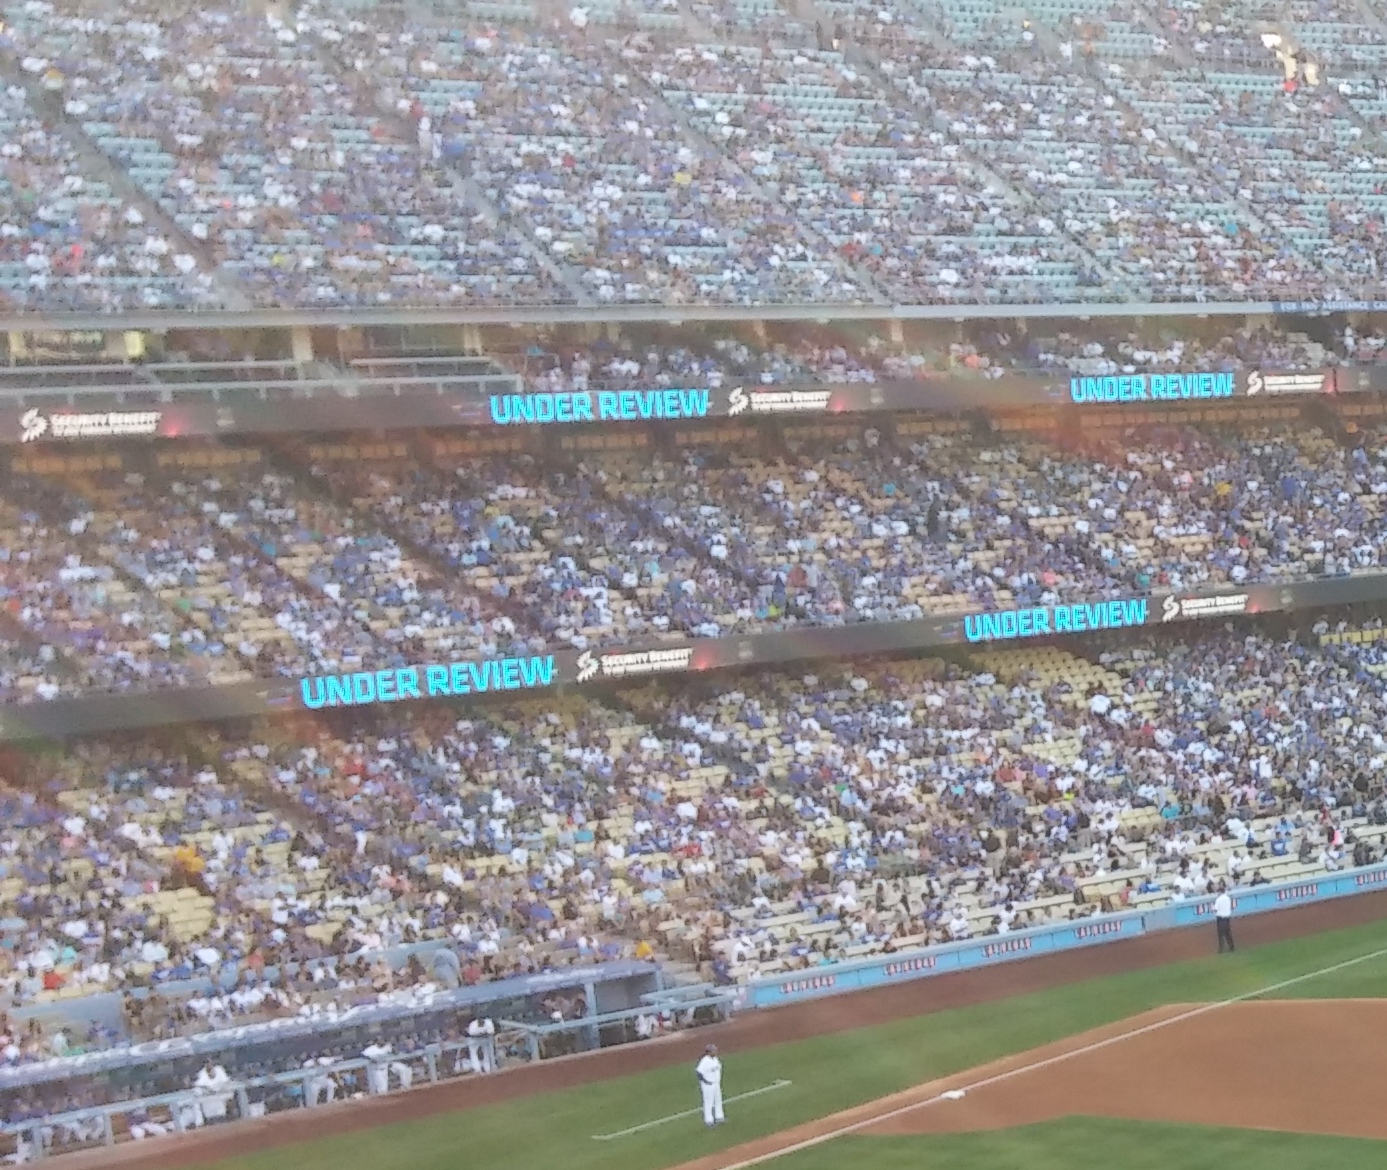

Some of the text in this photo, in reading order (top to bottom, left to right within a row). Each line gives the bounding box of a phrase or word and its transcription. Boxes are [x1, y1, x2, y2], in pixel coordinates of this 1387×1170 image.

[490, 388, 709, 424] UNDER REVIEW
[1070, 373, 1234, 402] UNDER REVIEW
[964, 599, 1147, 642] UNDER REVIEW
[300, 655, 554, 708] UNDER REVIEW
